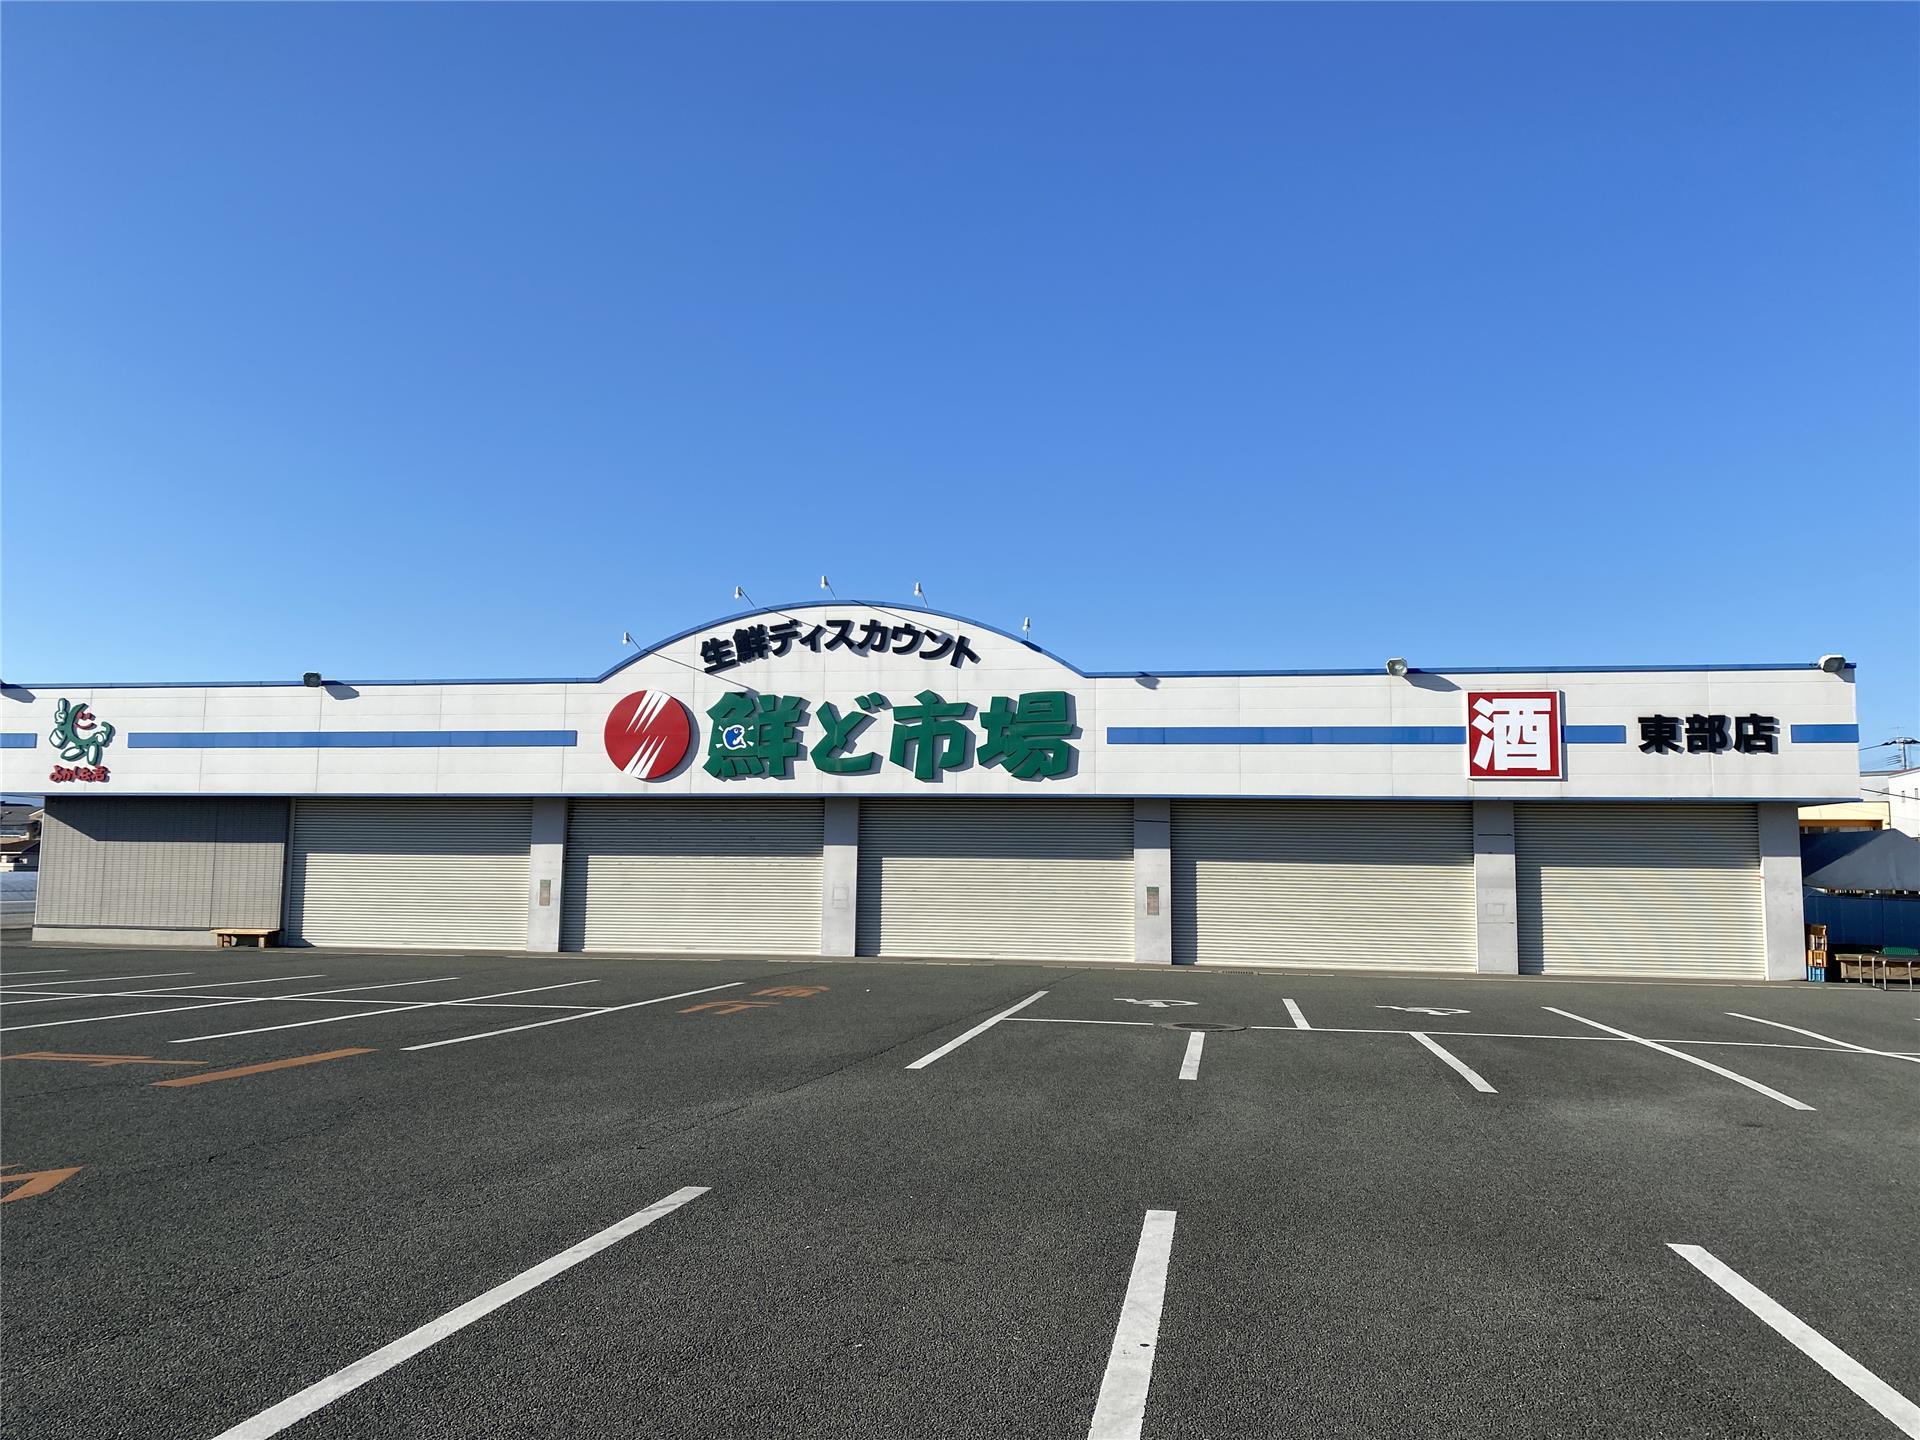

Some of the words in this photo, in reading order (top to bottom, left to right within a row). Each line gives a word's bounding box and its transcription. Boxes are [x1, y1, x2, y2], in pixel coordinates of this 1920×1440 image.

[701, 618, 981, 674] 生鮮ディスカウント
[703, 690, 1083, 781] 鮮ど市場
[1471, 697, 1552, 771] 酒
[1637, 714, 1780, 755] 東部店
